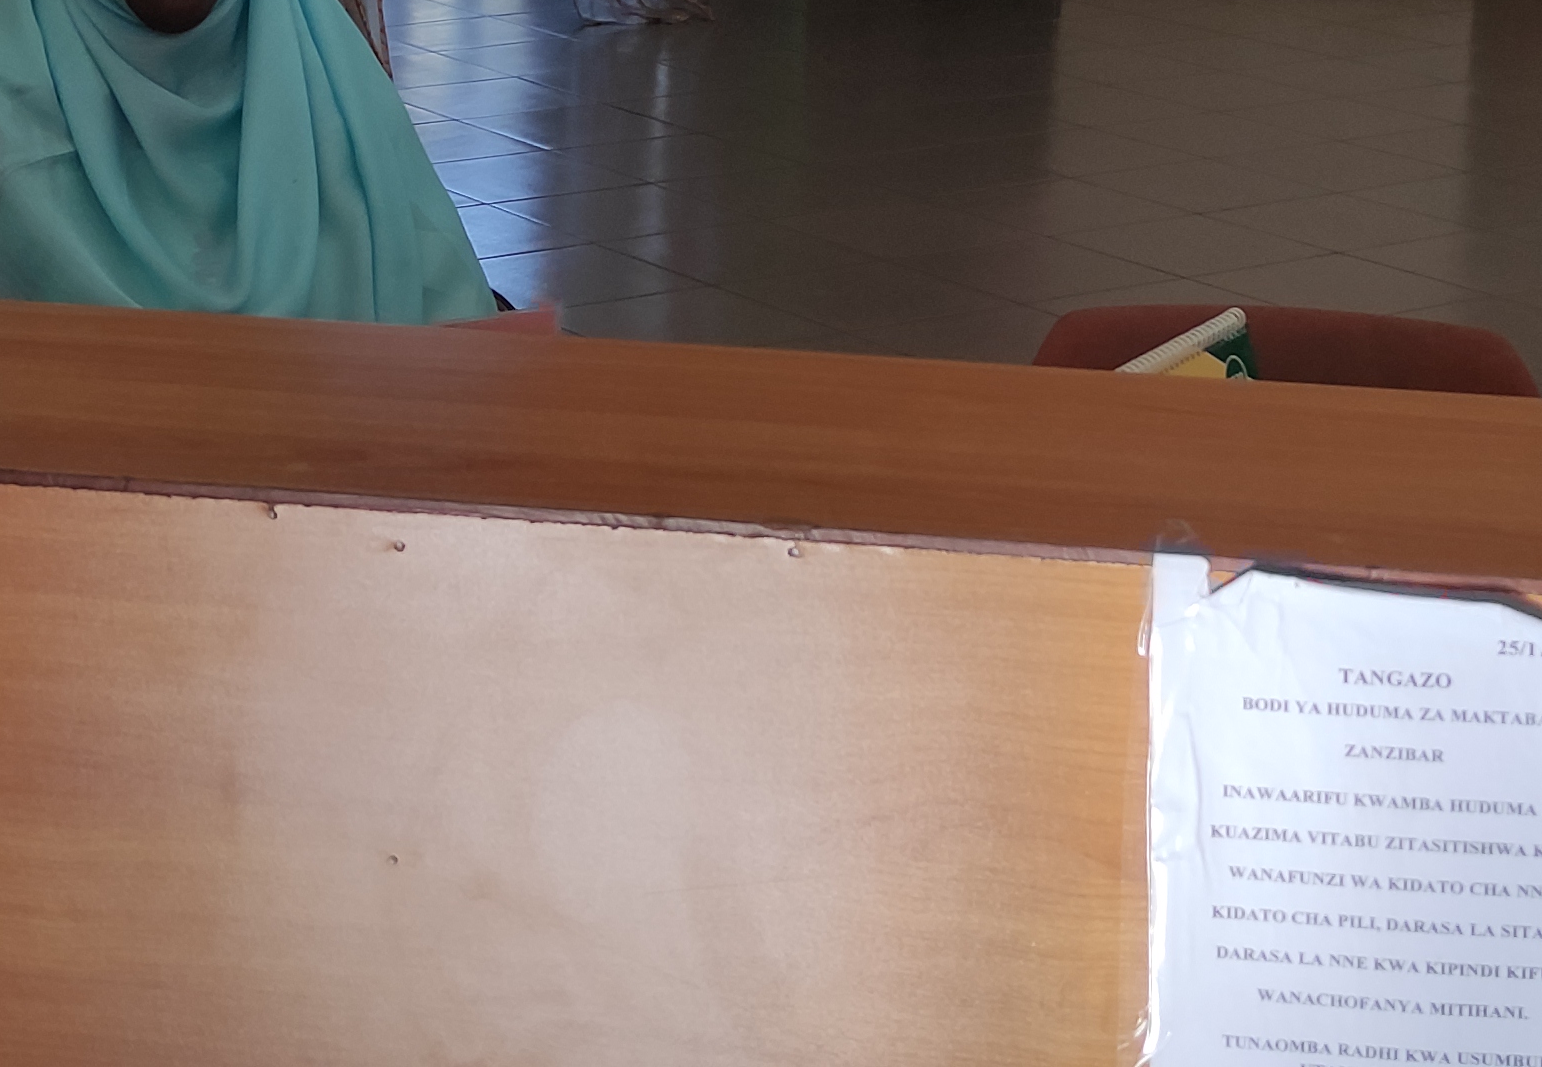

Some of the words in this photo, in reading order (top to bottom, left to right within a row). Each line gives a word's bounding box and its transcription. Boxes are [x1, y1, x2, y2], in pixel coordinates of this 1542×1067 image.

[1337, 667, 1453, 690] TANGAZO
[1242, 696, 1290, 714] BODI
[1294, 699, 1323, 716] YA
[1326, 701, 1415, 721] HUDUMA
[1419, 707, 1446, 723] ZA
[1344, 743, 1445, 764] ZANZIBAR
[1222, 783, 1348, 806] INAWAARIFU
[1353, 792, 1445, 812] KWAMBA
[1449, 798, 1538, 817] HUDUMA
[1209, 823, 1303, 844] KUAZIMA
[1307, 830, 1379, 849] VITABU
[1384, 836, 1528, 858] ZITASITISHWA
[1228, 865, 1346, 888] WANAFUNZI
[1350, 874, 1383, 891] WA
[1387, 876, 1465, 895] KIDATO
[1468, 882, 1512, 898] CHA
[1211, 904, 1288, 924] KIDATO
[1290, 911, 1333, 927] CHA
[1337, 913, 1382, 933] PILI,
[1386, 917, 1464, 936] DARASA
[1470, 922, 1496, 938] LA
[1216, 945, 1293, 965] DARASA
[1298, 951, 1324, 967] LA
[1329, 953, 1368, 970] NNE
[1373, 957, 1420, 974] KWA
[1425, 960, 1501, 979] KIPINDI
[1221, 1033, 1333, 1056] TUNAOMBA
[1337, 1042, 1399, 1062] RADHI
[1405, 1048, 1452, 1065] KWA
